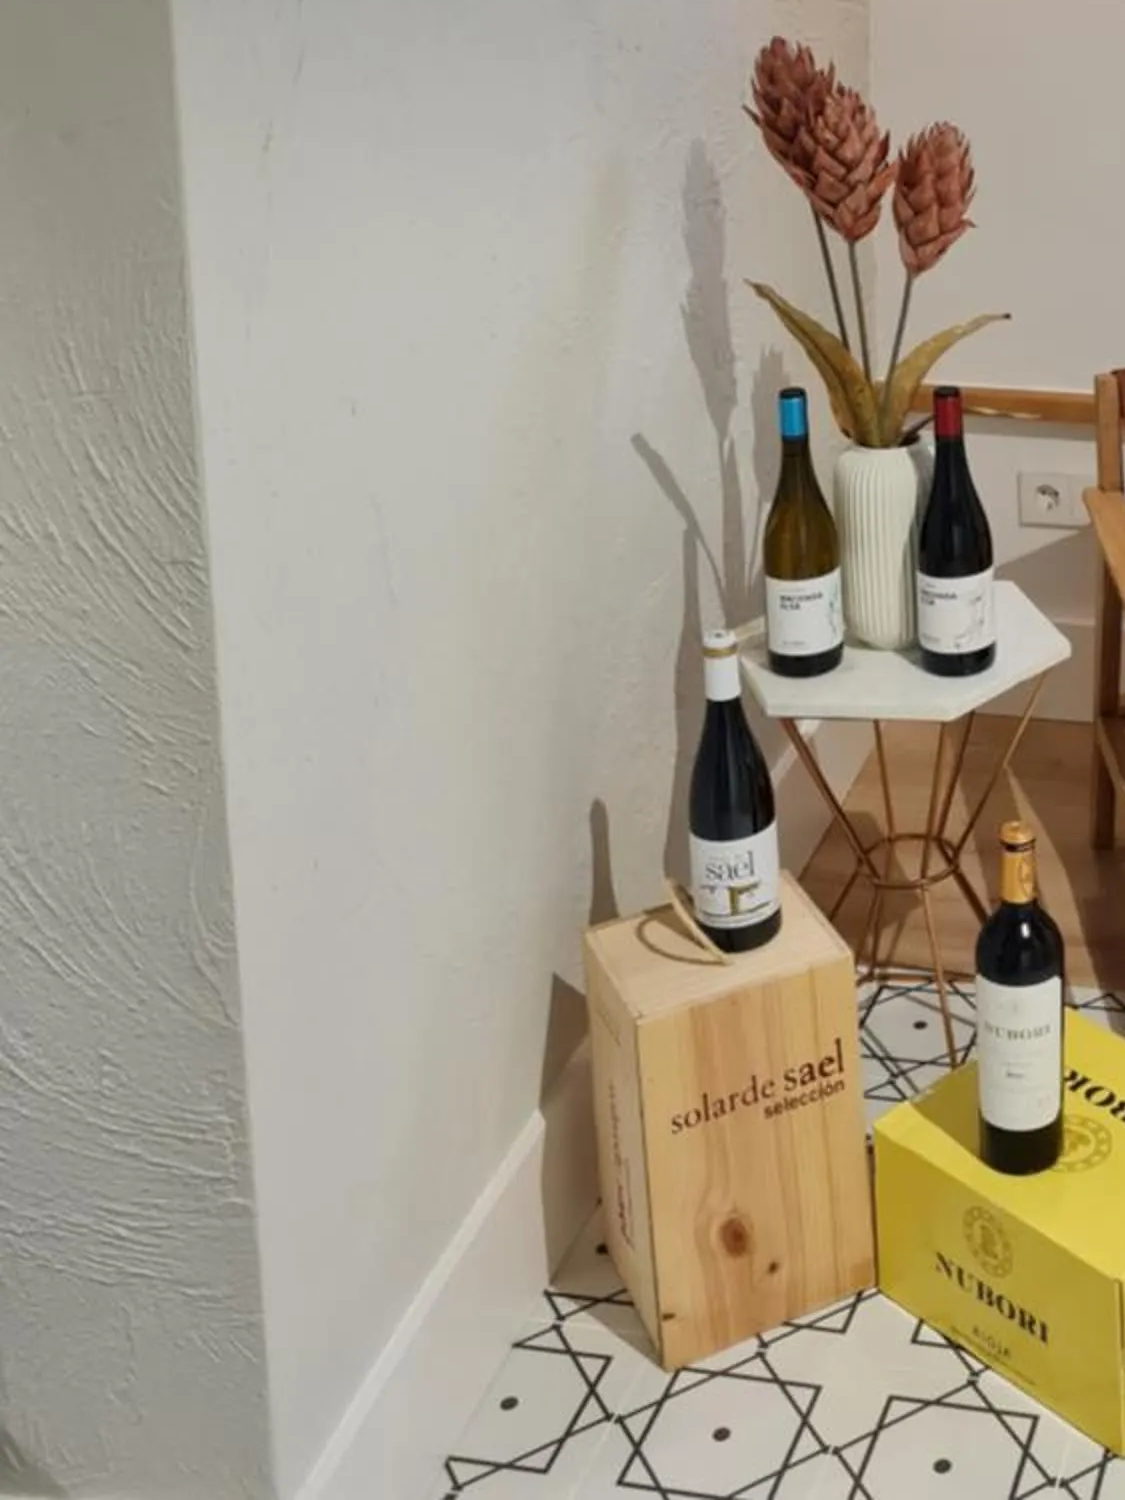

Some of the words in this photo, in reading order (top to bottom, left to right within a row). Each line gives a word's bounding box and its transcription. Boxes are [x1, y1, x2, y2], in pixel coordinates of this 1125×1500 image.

[705, 850, 755, 881] sael
[783, 1037, 844, 1092] sael
[934, 1251, 1049, 1346] NUBORI
